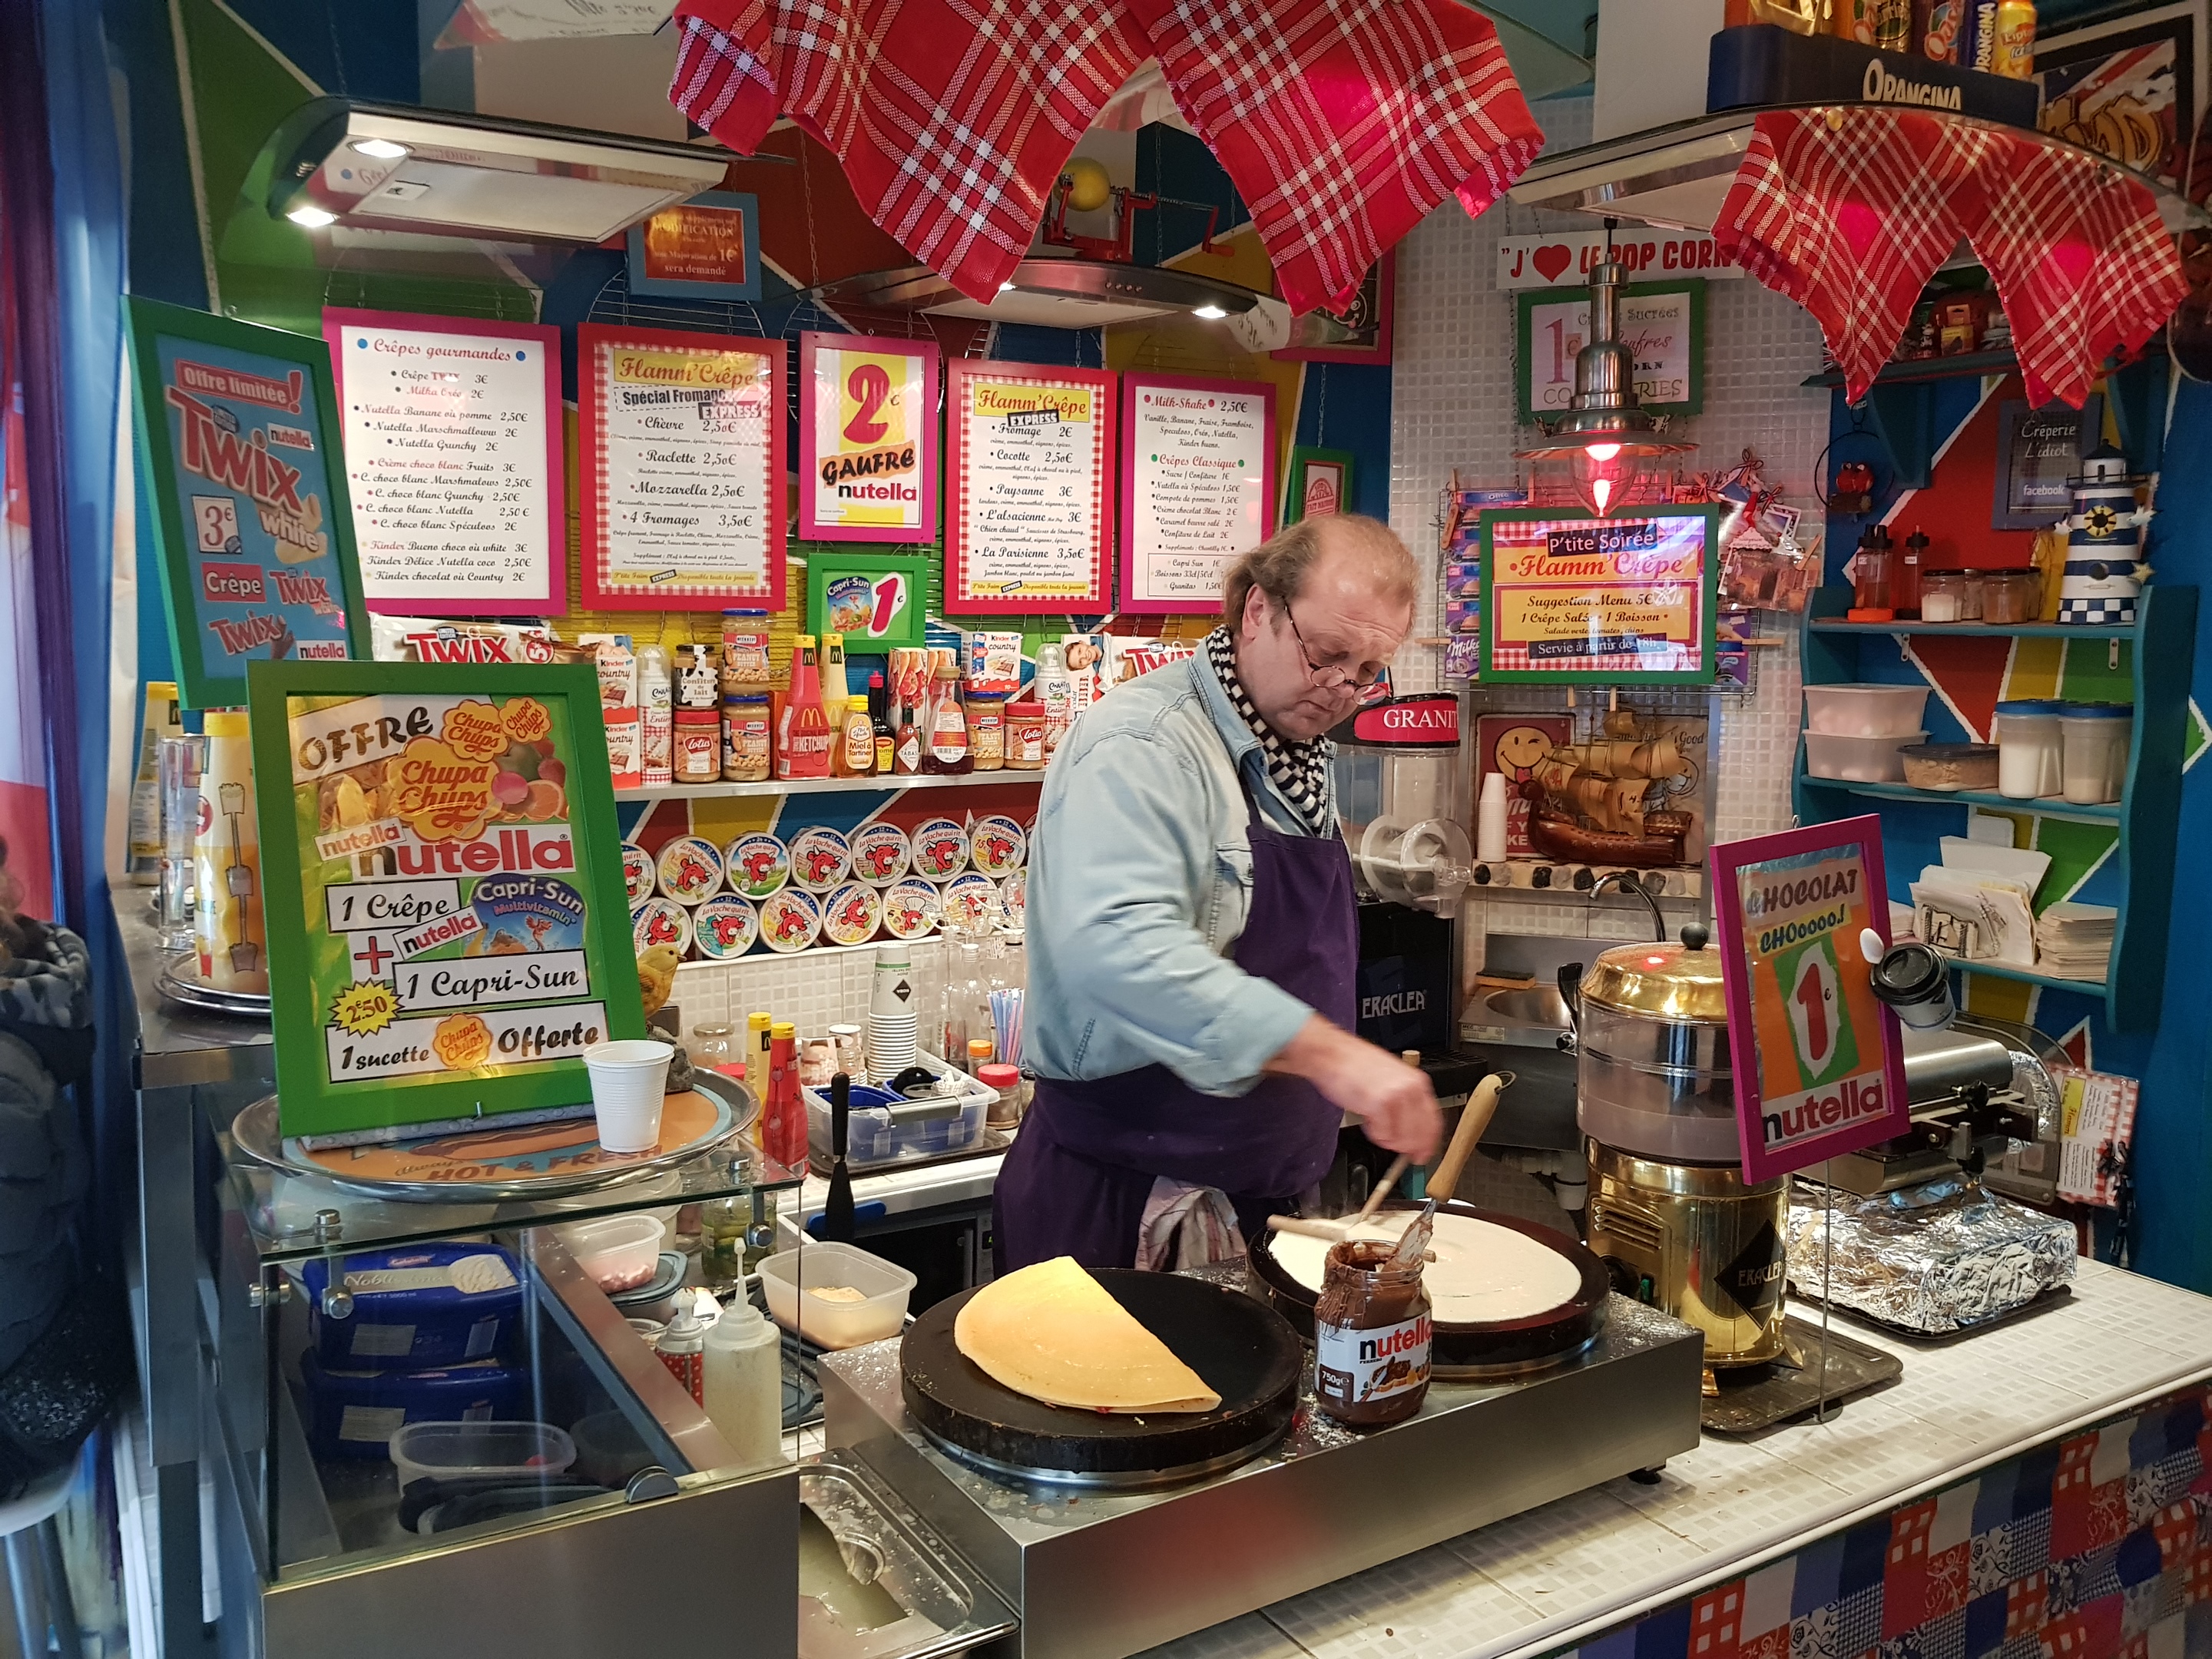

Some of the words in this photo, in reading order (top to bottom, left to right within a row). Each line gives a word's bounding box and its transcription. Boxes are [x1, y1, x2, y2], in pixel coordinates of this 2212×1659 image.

[1863, 58, 1961, 111] ORANGINA
[686, 265, 727, 275] demandé
[374, 338, 421, 358] Crêpes
[426, 347, 511, 361] gourmandes
[183, 366, 227, 393] Offre
[401, 370, 429, 381] Crêpe
[475, 375, 488, 384] 3€
[623, 391, 671, 406] Spécial
[843, 364, 890, 443] 2
[1151, 396, 1207, 409] Milk-Shake
[1220, 401, 1248, 413] 2,50€
[361, 404, 401, 415] Nutella
[404, 406, 442, 418] Banane
[459, 412, 492, 421] pomme
[500, 412, 528, 422] 2,50€
[703, 405, 760, 419] EXPRESS
[1010, 413, 1057, 426] EXPRESS
[373, 422, 412, 432] Nutella
[645, 416, 684, 430] Chèvre
[998, 423, 1041, 439] Fromage
[1059, 427, 1072, 437] 2€
[270, 426, 313, 451] nutella
[396, 438, 433, 448] Nutella
[646, 449, 696, 463] Raclette
[997, 449, 1030, 461] Cocotte
[1160, 454, 1189, 469] Crêpes
[1193, 456, 1236, 470] Classique
[378, 458, 407, 469] Crème
[410, 459, 435, 469] choco
[438, 460, 463, 470] blanc
[466, 462, 494, 472] Fruits
[503, 463, 516, 472] 3€
[823, 447, 915, 485] GAUFRE
[1189, 472, 1217, 480] Confiture
[635, 481, 708, 495] Mozzarella
[838, 482, 916, 502] nutella
[996, 484, 1044, 498] Paysanne
[1059, 486, 1072, 496] 3€
[2023, 485, 2064, 495] facebook
[1156, 494, 1181, 502] Compote
[630, 512, 637, 523] 4
[642, 512, 700, 528] Fromages
[986, 509, 1046, 522] L'alsacienne
[1068, 512, 1081, 522] 3€
[260, 509, 320, 553] white
[449, 521, 495, 532] Spéculoos
[505, 522, 517, 531] 2€
[1164, 530, 1192, 538] Confiture
[370, 541, 405, 551] Kinder
[408, 541, 438, 551] Bueno
[442, 543, 465, 551] choco
[483, 543, 506, 552] white
[1549, 537, 1594, 553] P'tite
[1599, 530, 1654, 550] Soirée
[982, 547, 995, 558] La
[998, 547, 1048, 558] Parisienne
[367, 556, 401, 565] Kinder
[405, 557, 433, 565] Délice
[437, 557, 474, 566] Nutella
[505, 558, 531, 568] 2,50€
[205, 571, 262, 596] Crêpe
[375, 571, 409, 581] Kinder
[412, 571, 450, 581] chocolat
[468, 573, 504, 584] Country
[513, 573, 525, 581] 2€
[1170, 582, 1196, 591] Granitas
[827, 577, 869, 596] Capri-Sun
[872, 578, 897, 632] 1
[1528, 595, 1591, 610] Suggestion
[1595, 594, 1631, 605] Menu
[1530, 613, 1560, 625] Crêpe
[1615, 611, 1660, 622] Boisson
[299, 642, 346, 659] nutella
[988, 642, 1017, 652] country
[1538, 643, 1572, 654] Servie
[1586, 640, 1616, 654] partir
[453, 711, 502, 734] Chupa
[505, 700, 533, 730] Chupa
[298, 706, 434, 770] OFFRE
[799, 737, 830, 751] KETCHUP
[401, 760, 489, 784] Chupa
[322, 823, 401, 856] nutella
[925, 832, 944, 841] Vache
[359, 830, 575, 877] nutella
[475, 878, 584, 915] Capri-Sun
[1746, 869, 1857, 914] CHOCOLAT
[342, 896, 355, 922] 1
[367, 892, 450, 923] Crêpe
[402, 912, 478, 954] nutella
[408, 973, 419, 999] 1
[432, 964, 579, 1002] Capri-Sun
[1362, 991, 1426, 1018] ERACLEA
[440, 1021, 478, 1048] Chupa
[498, 1023, 599, 1058] Offerte
[1762, 1079, 1885, 1143] nutella
[426, 1163, 504, 1181] HOT
[1322, 1370, 1341, 1386] 750g
